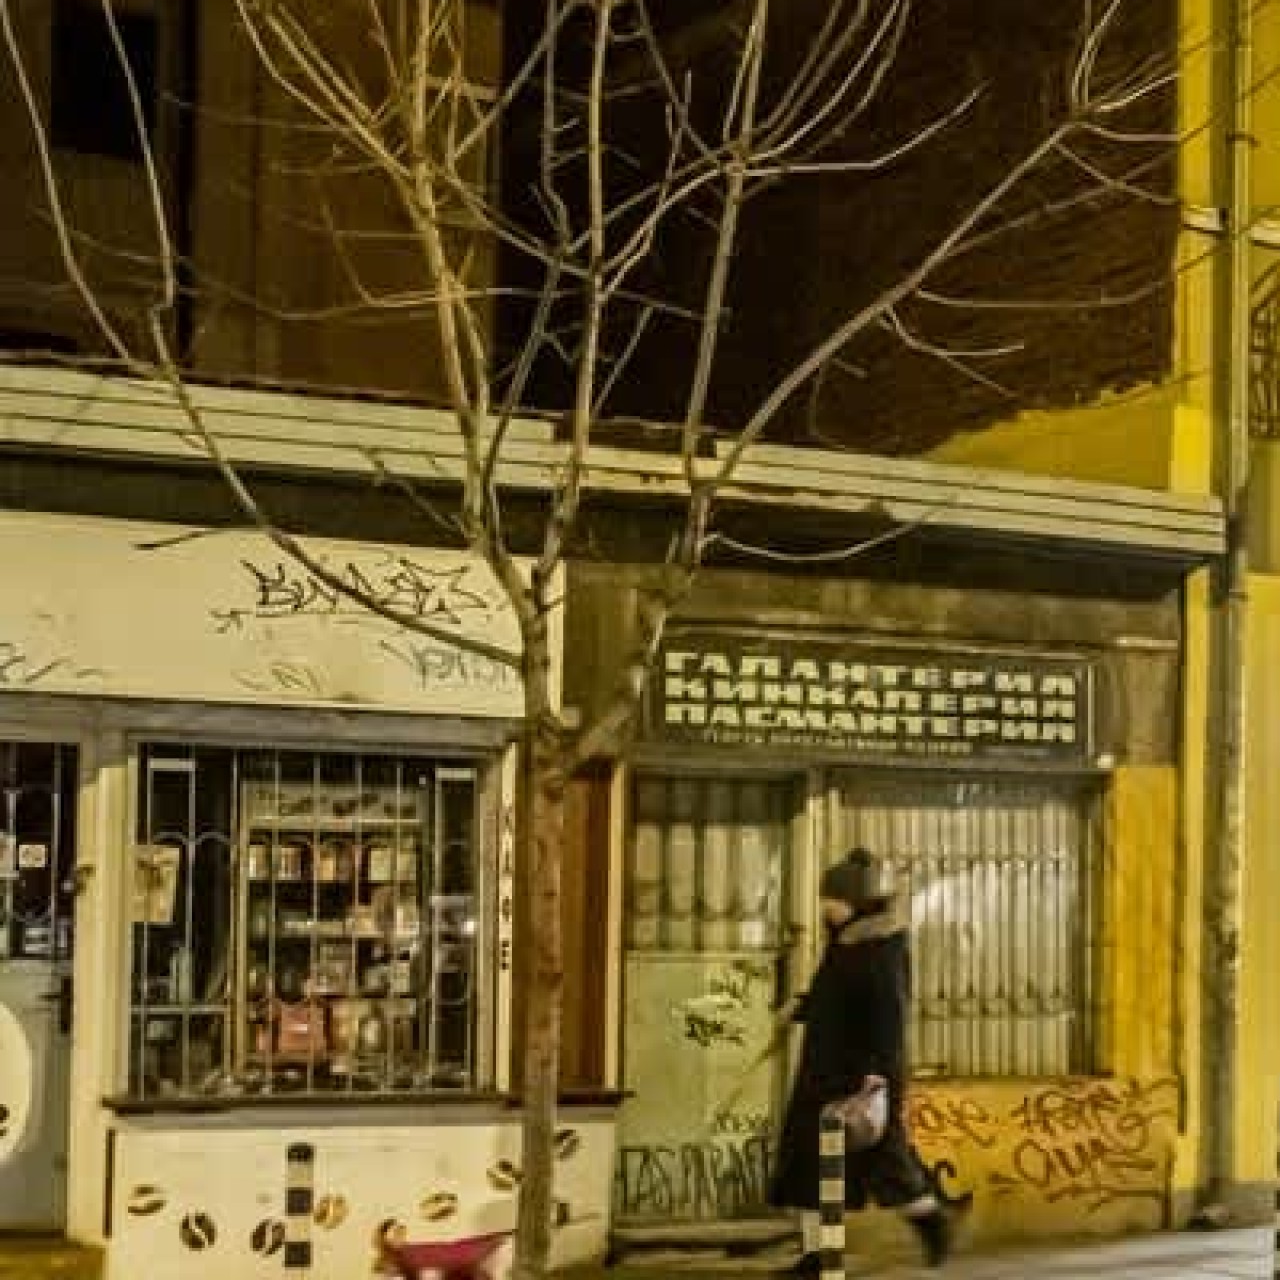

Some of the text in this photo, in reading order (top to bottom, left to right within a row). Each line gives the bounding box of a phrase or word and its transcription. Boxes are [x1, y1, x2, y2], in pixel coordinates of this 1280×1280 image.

[665, 652, 1076, 695] ГАЛАНТЕРИЯ
[665, 677, 1076, 718] КИНКАЛЕРИЯ
[665, 703, 1076, 742] ПАСМАНТЕРИЯ
